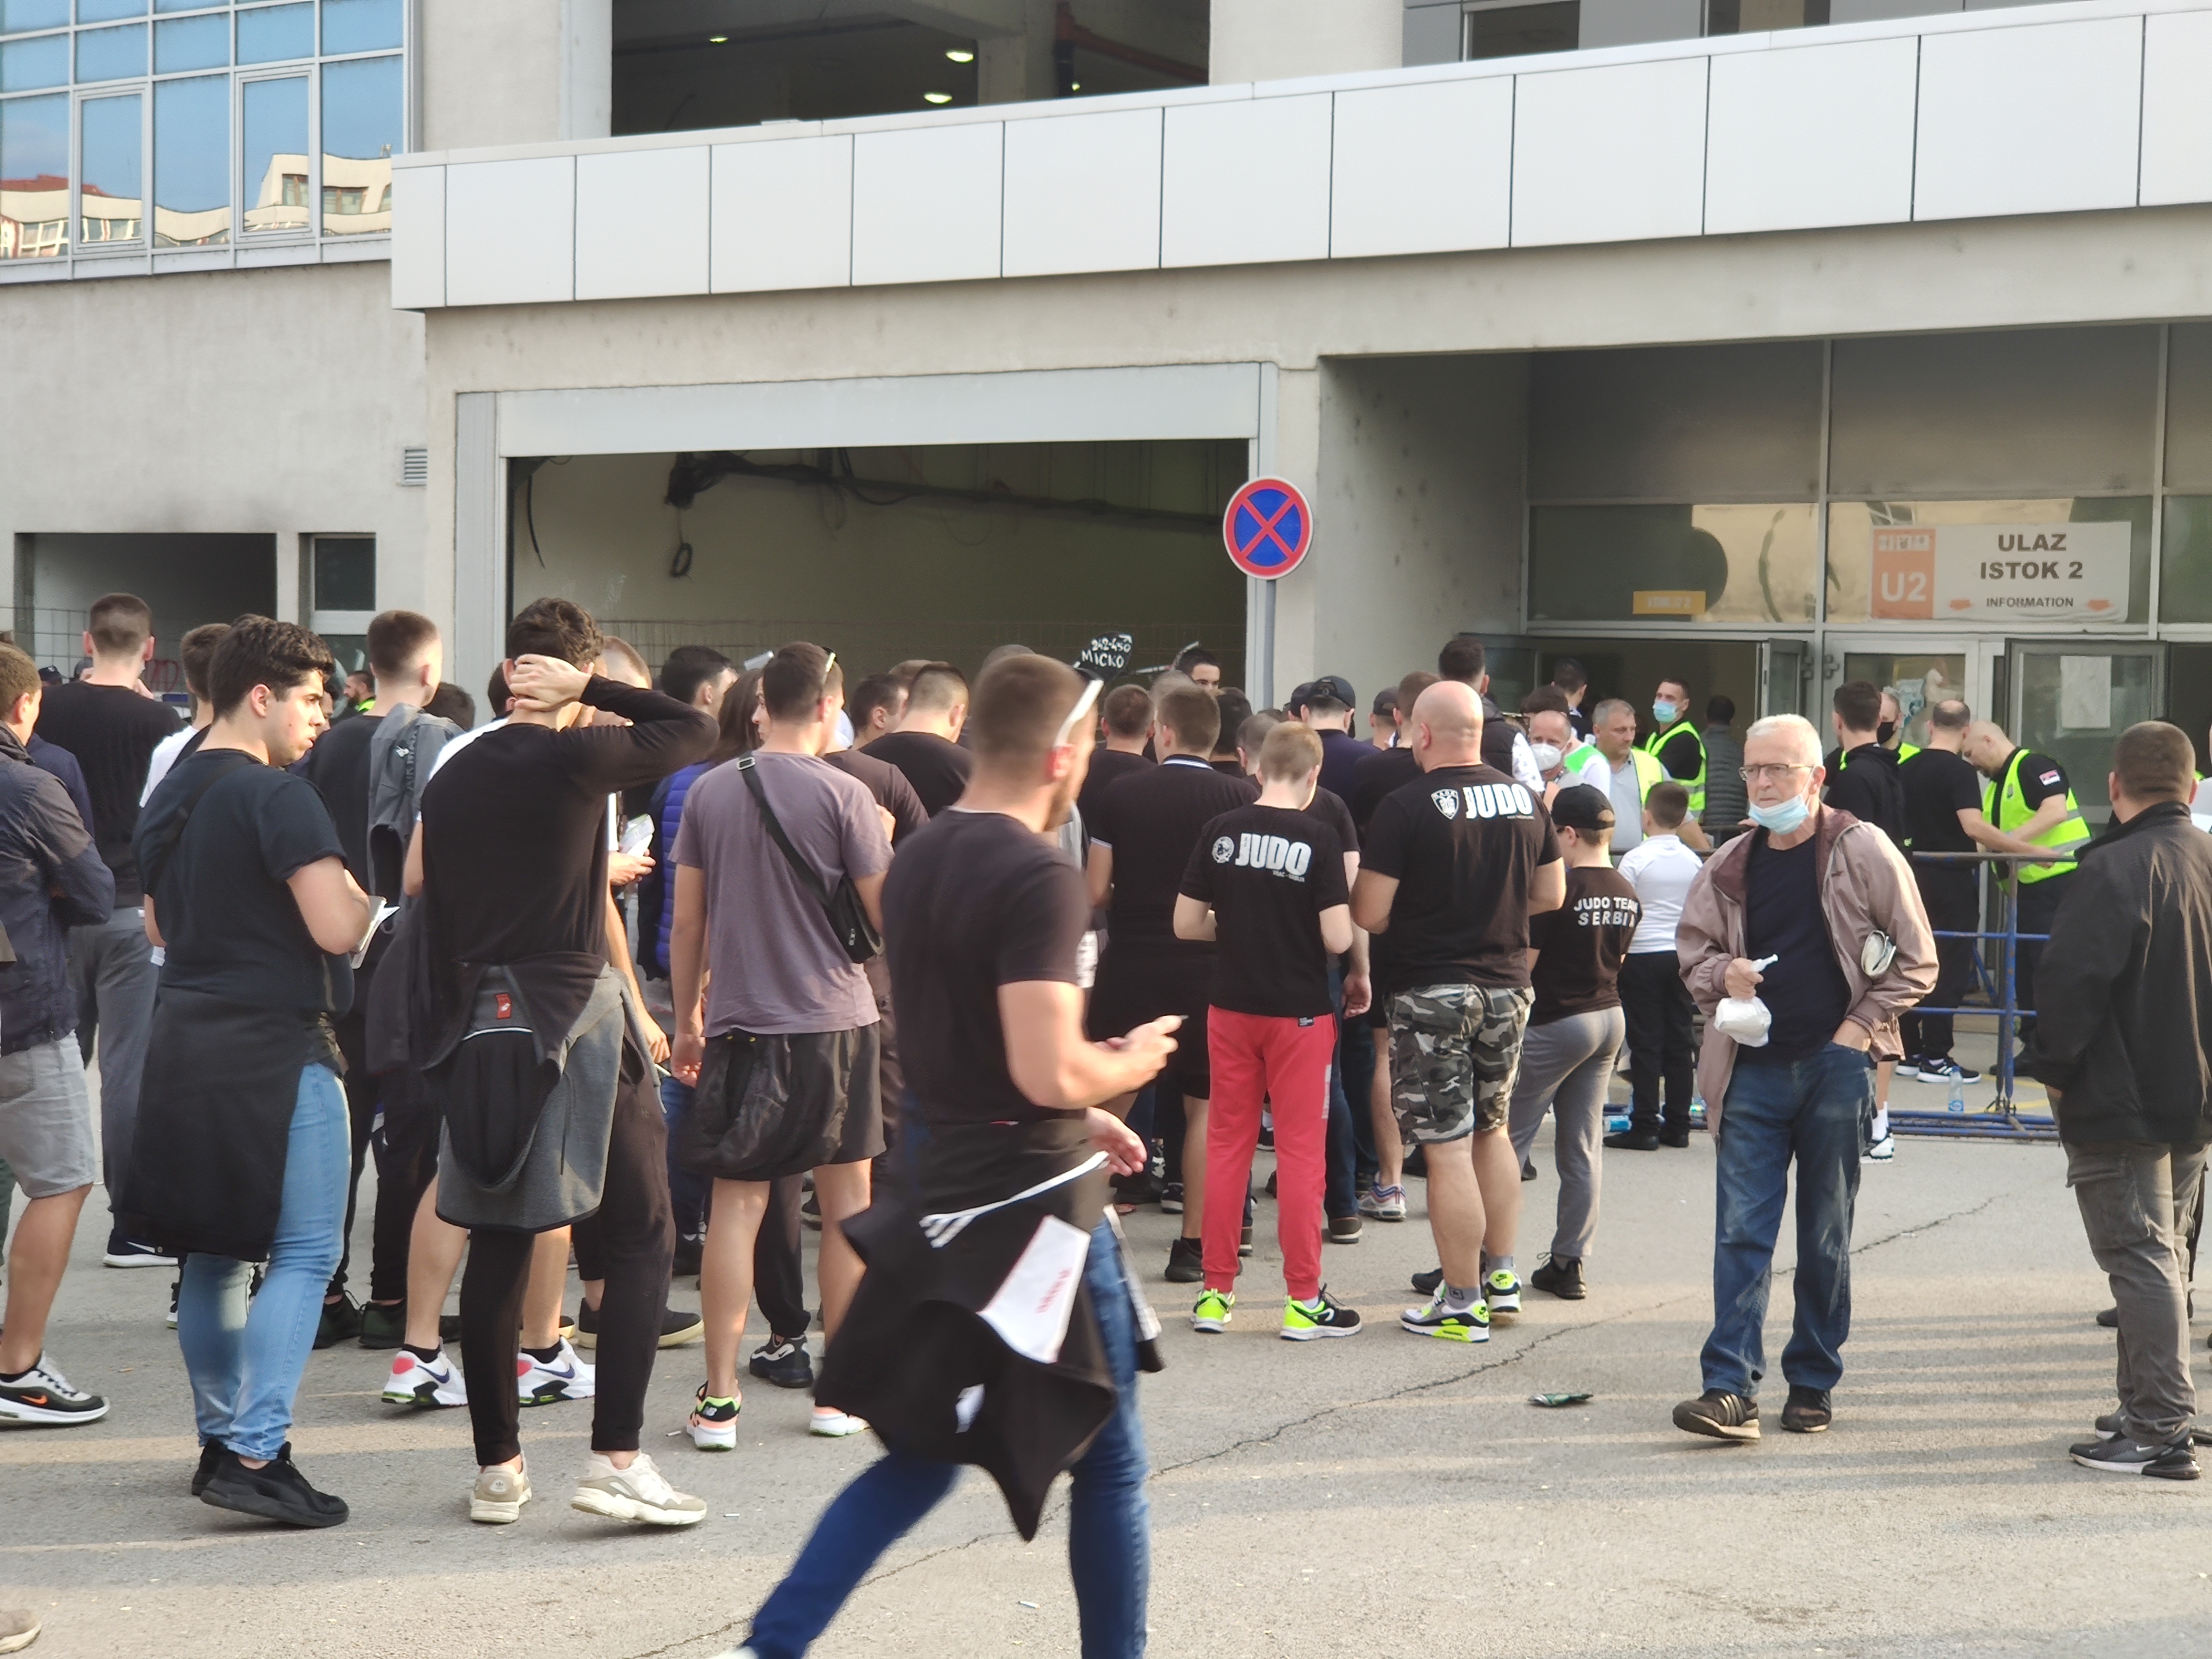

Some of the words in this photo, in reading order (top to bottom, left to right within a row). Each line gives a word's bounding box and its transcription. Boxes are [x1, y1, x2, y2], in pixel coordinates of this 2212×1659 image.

[1998, 534, 2067, 551] ULAZ
[1981, 562, 2059, 580] ISTOK
[2068, 561, 2083, 580] 2
[1881, 572, 1927, 602] U2
[1986, 597, 2074, 607] INFORMATION
[1462, 783, 1533, 820] JUDO
[1234, 833, 1312, 876] JUDO
[1573, 896, 1610, 912] JUDO
